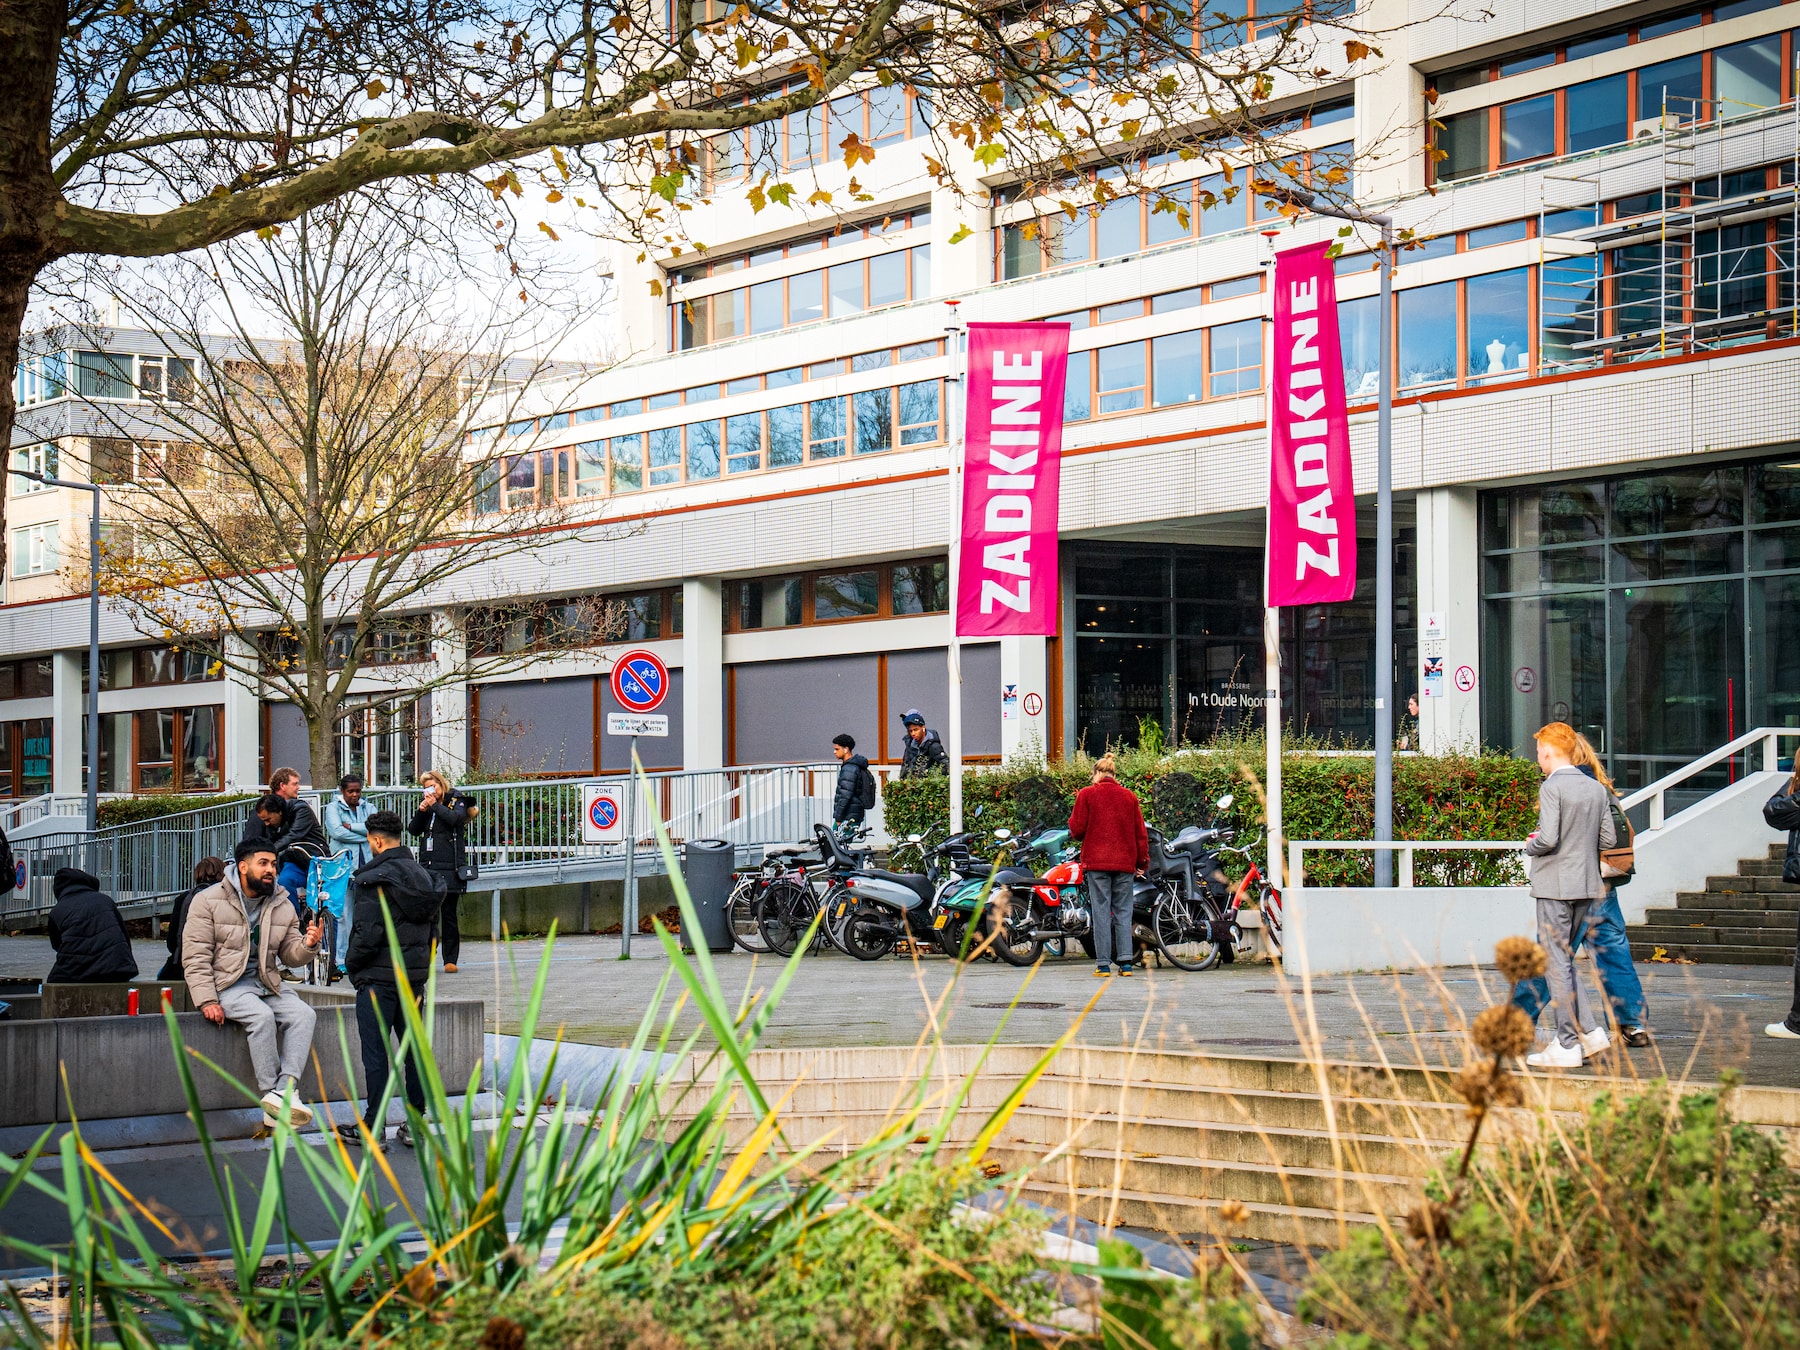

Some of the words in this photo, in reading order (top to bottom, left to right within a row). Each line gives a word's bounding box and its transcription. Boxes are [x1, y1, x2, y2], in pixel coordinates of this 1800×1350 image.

[980, 350, 1043, 614] ZADKINE
[1289, 276, 1340, 581] ZADKINE
[1189, 693, 1198, 706] In
[1210, 692, 1238, 707] Oude
[1221, 682, 1251, 690] BRASSERIE
